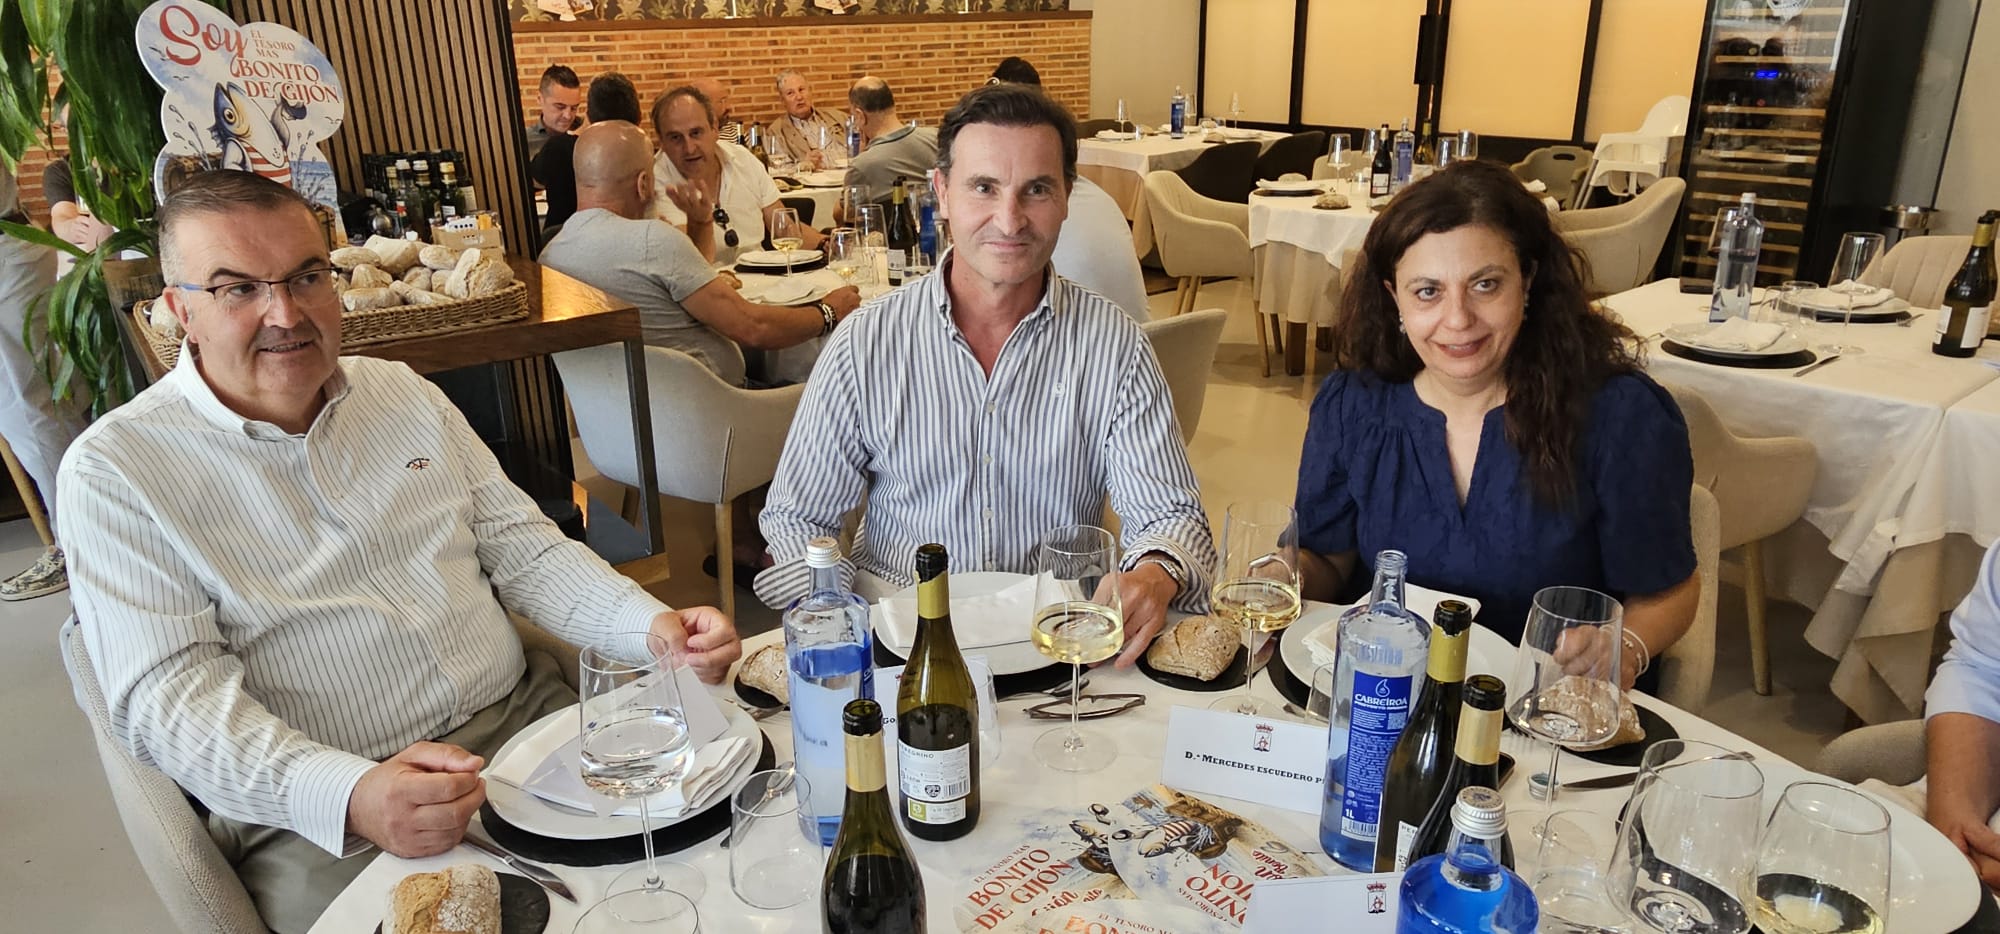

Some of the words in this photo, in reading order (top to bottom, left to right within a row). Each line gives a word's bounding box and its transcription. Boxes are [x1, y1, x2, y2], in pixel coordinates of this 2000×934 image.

[160, 5, 248, 77] Soy
[254, 39, 296, 51] TESORO
[238, 59, 319, 82] BONITO
[244, 80, 275, 99] DE
[281, 82, 340, 105] GIJÓN
[1256, 766, 1313, 782] ESCUEDERO
[968, 849, 1051, 908] BONITO
[973, 903, 1014, 931] DE
[1010, 859, 1074, 905] GIJÓN
